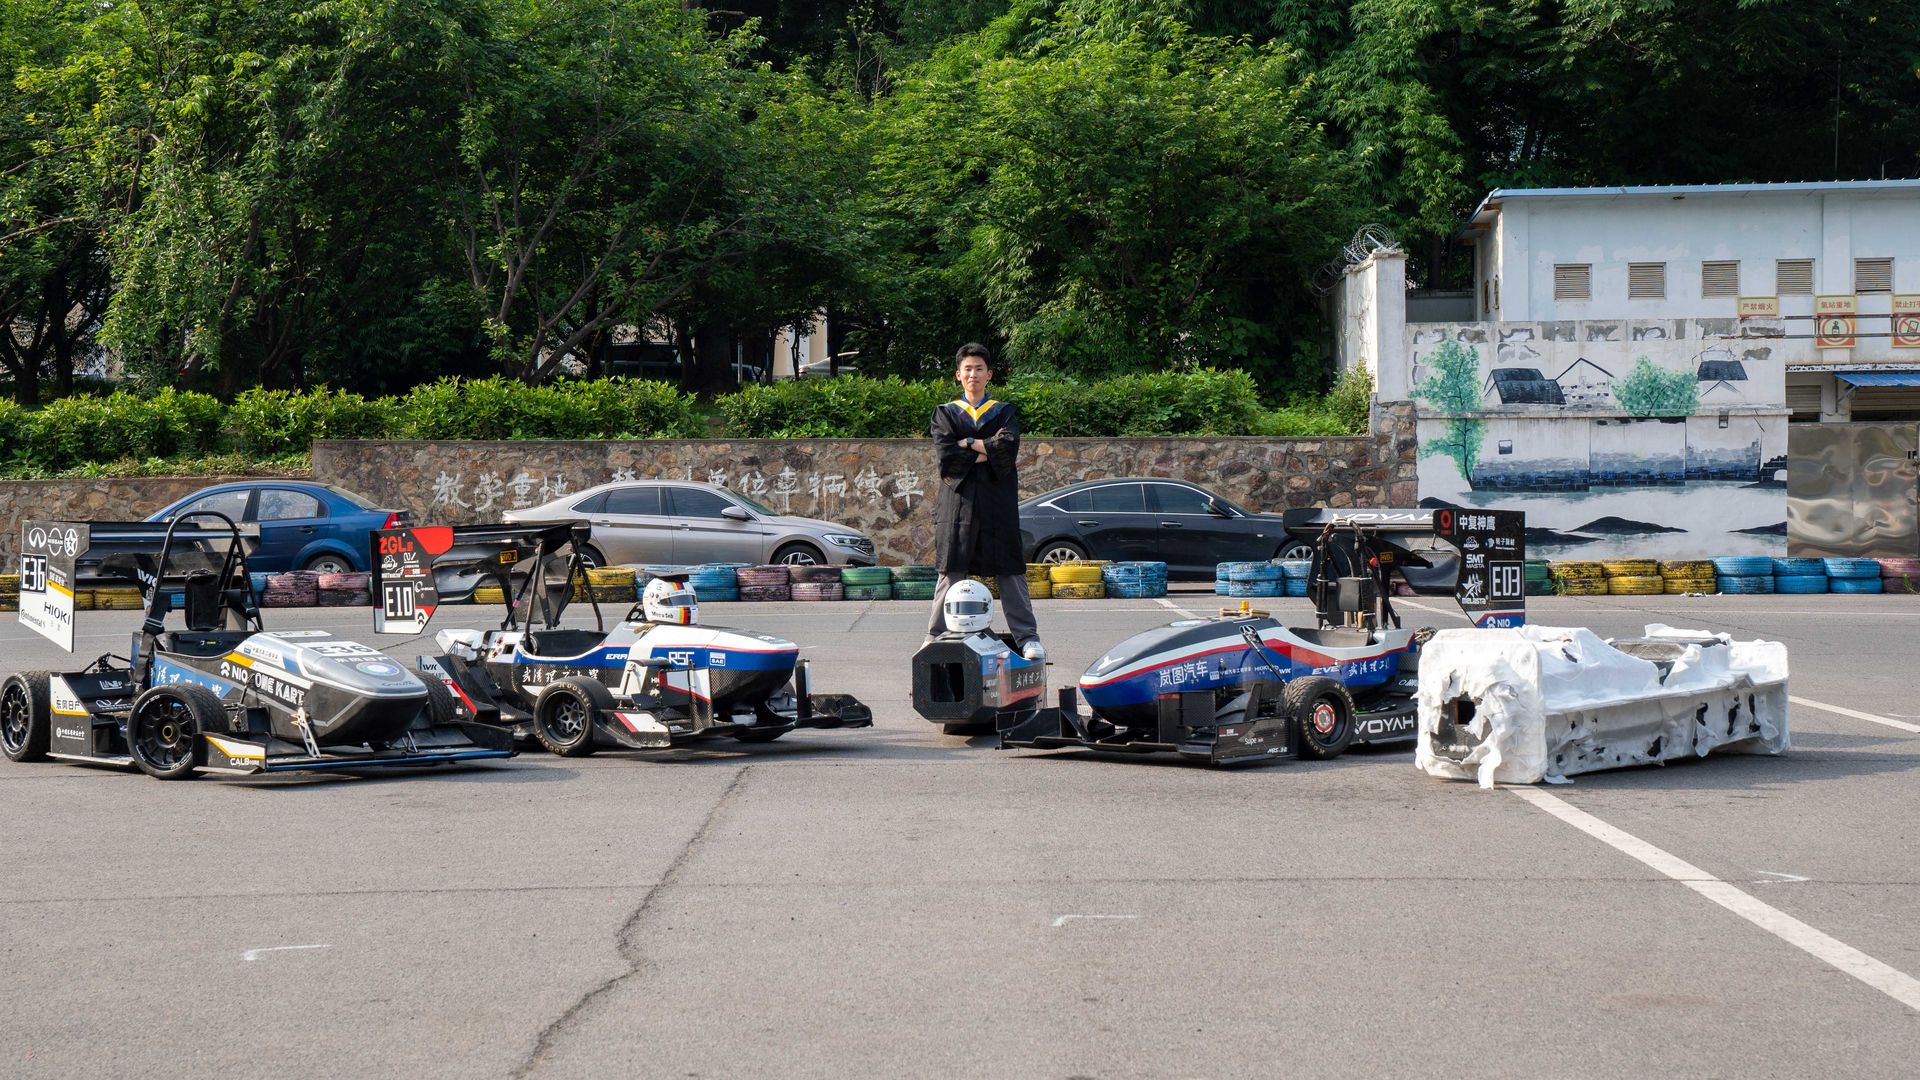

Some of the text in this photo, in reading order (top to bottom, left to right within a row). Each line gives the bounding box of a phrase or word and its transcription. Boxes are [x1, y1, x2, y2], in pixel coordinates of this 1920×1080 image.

[1742, 302, 1773, 311] 严禁烟火
[1459, 514, 1496, 531] 中复神鹰
[1466, 553, 1485, 564] SMT
[22, 557, 46, 591] E36
[1492, 566, 1520, 597] E03
[385, 587, 413, 617] E10
[44, 601, 71, 625] HIOKI
[1497, 618, 1511, 628] NIO
[308, 645, 374, 654] E36
[231, 664, 248, 685] NIO
[1159, 660, 1209, 688] 岚图汽车
[1311, 665, 1340, 675] EVE
[275, 680, 305, 706] KART
[1355, 715, 1415, 735] VOYAH
